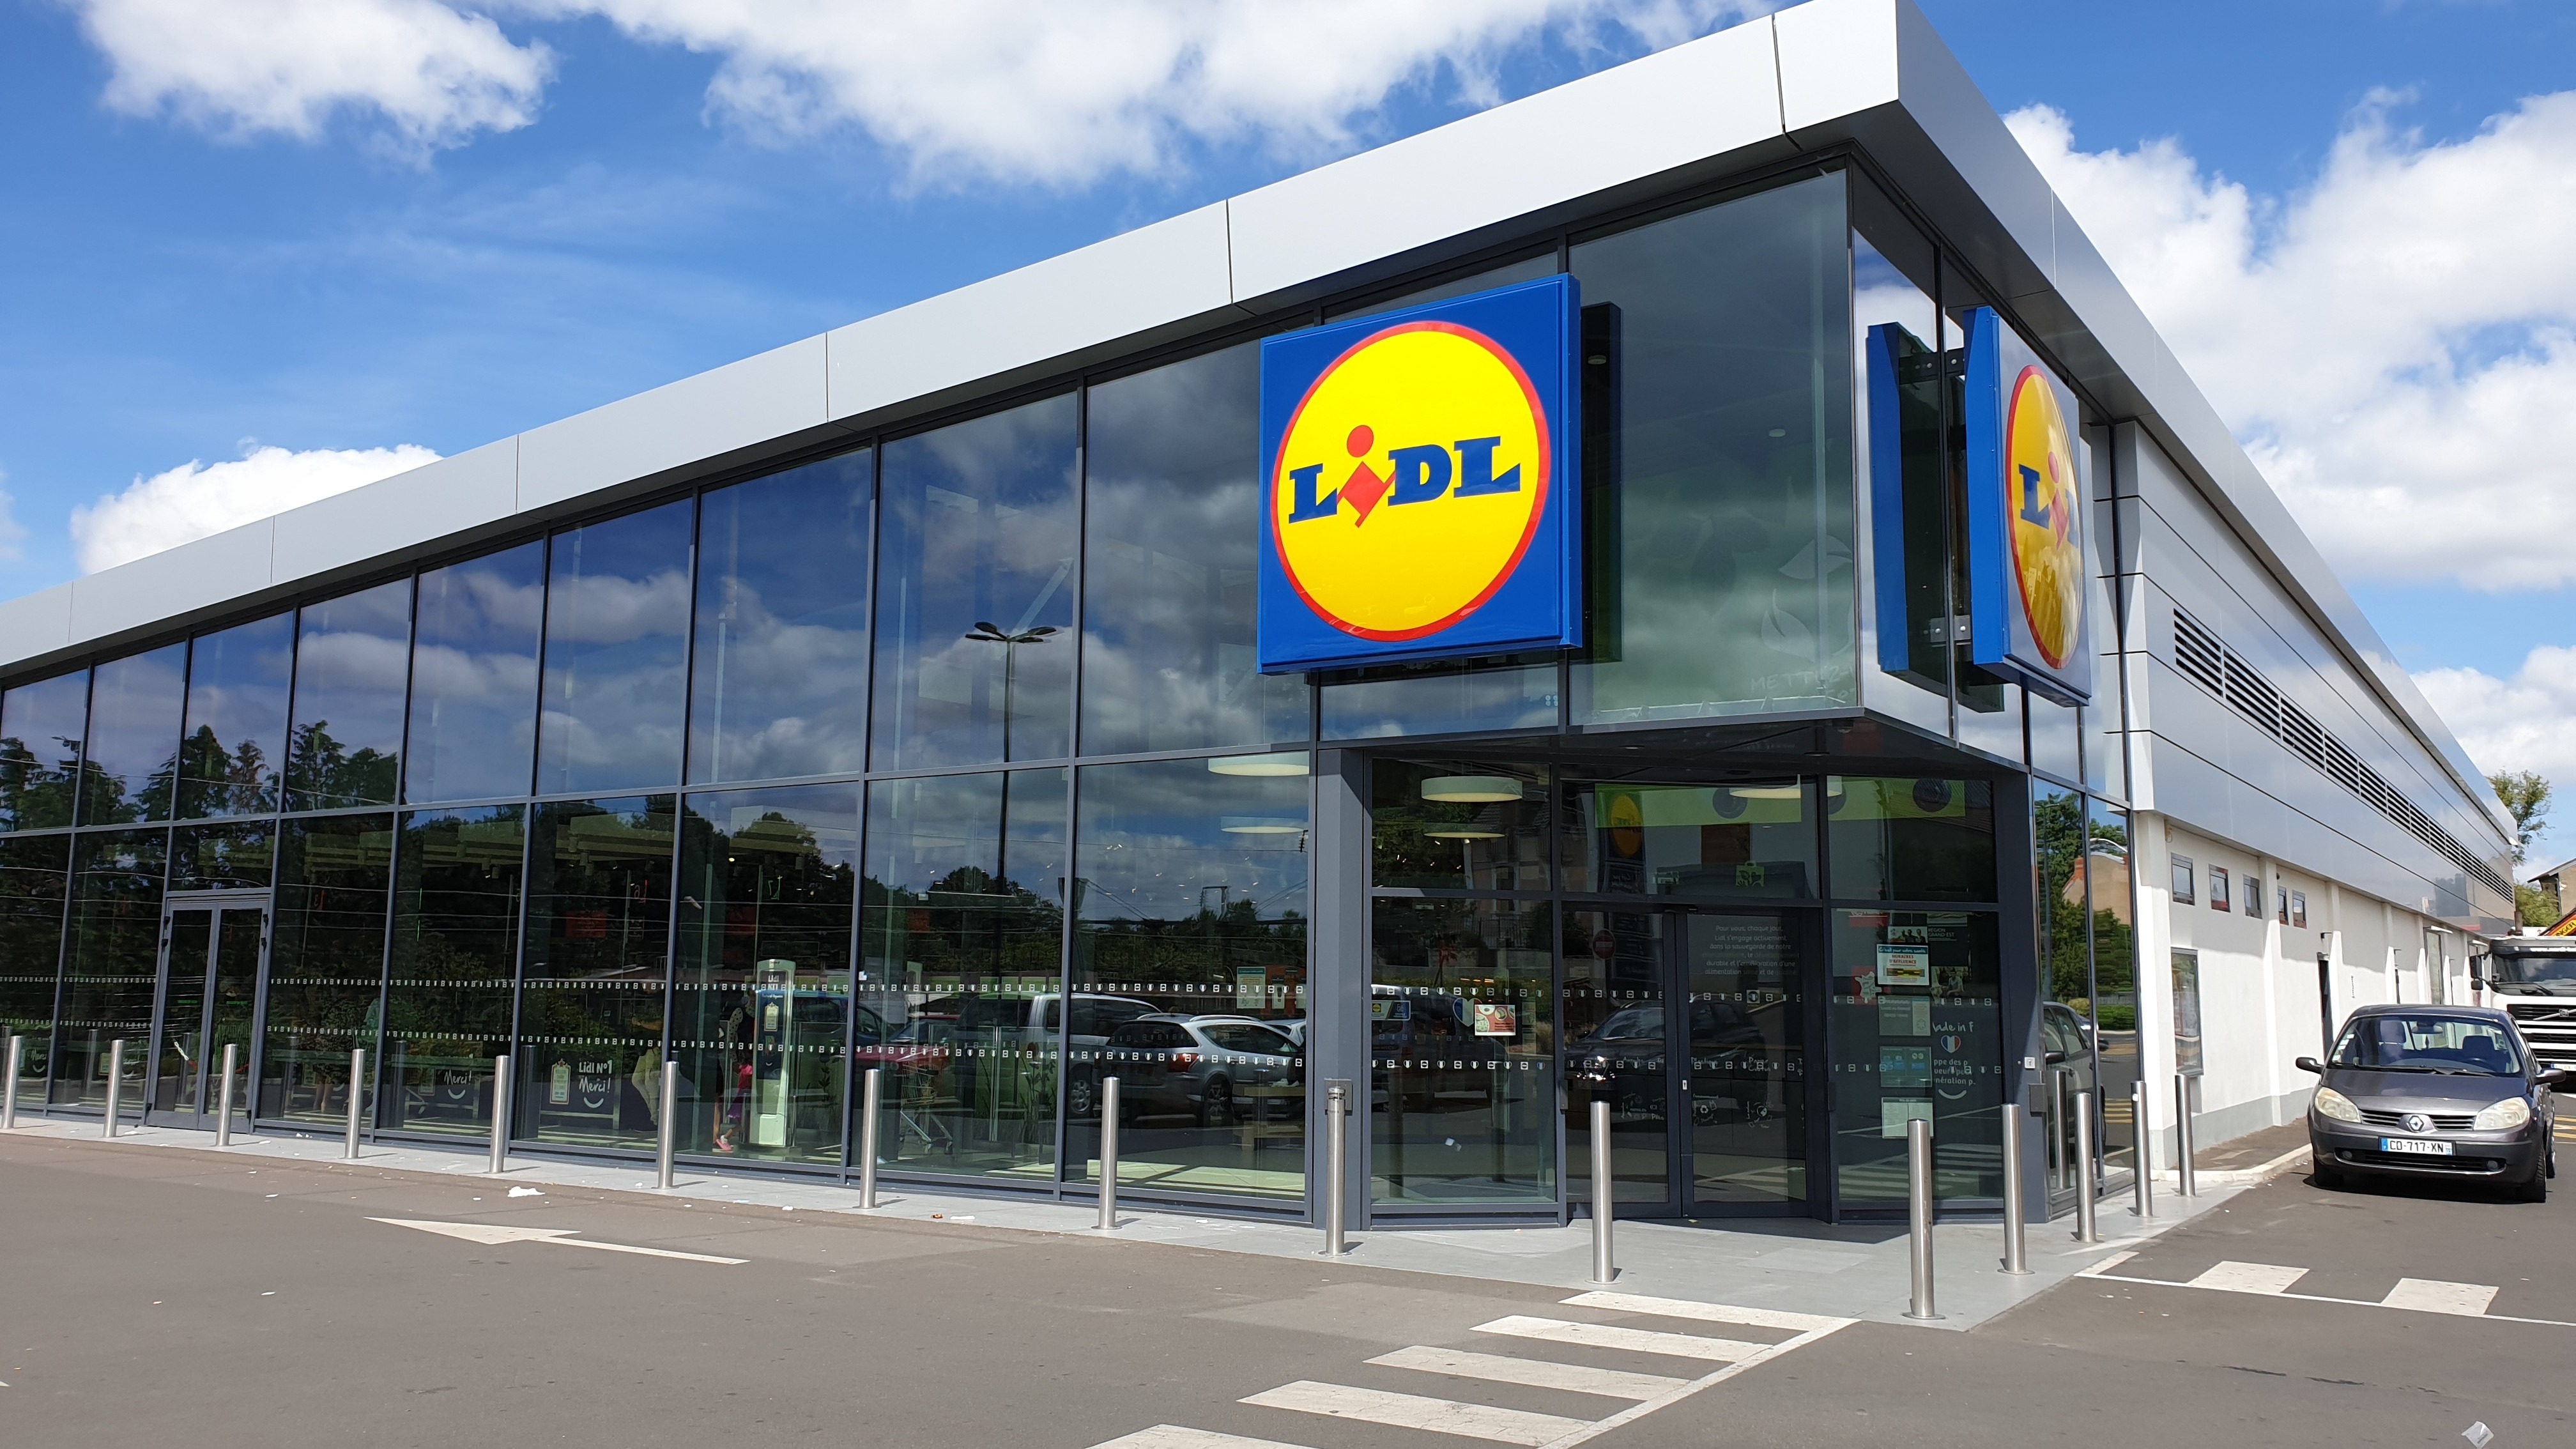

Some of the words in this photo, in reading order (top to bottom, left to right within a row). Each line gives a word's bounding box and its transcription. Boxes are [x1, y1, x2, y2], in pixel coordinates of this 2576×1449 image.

[1958, 1022, 1966, 1032] in
[578, 1061, 595, 1074] Lidl
[2389, 1140, 2444, 1153] CD-717-XN
